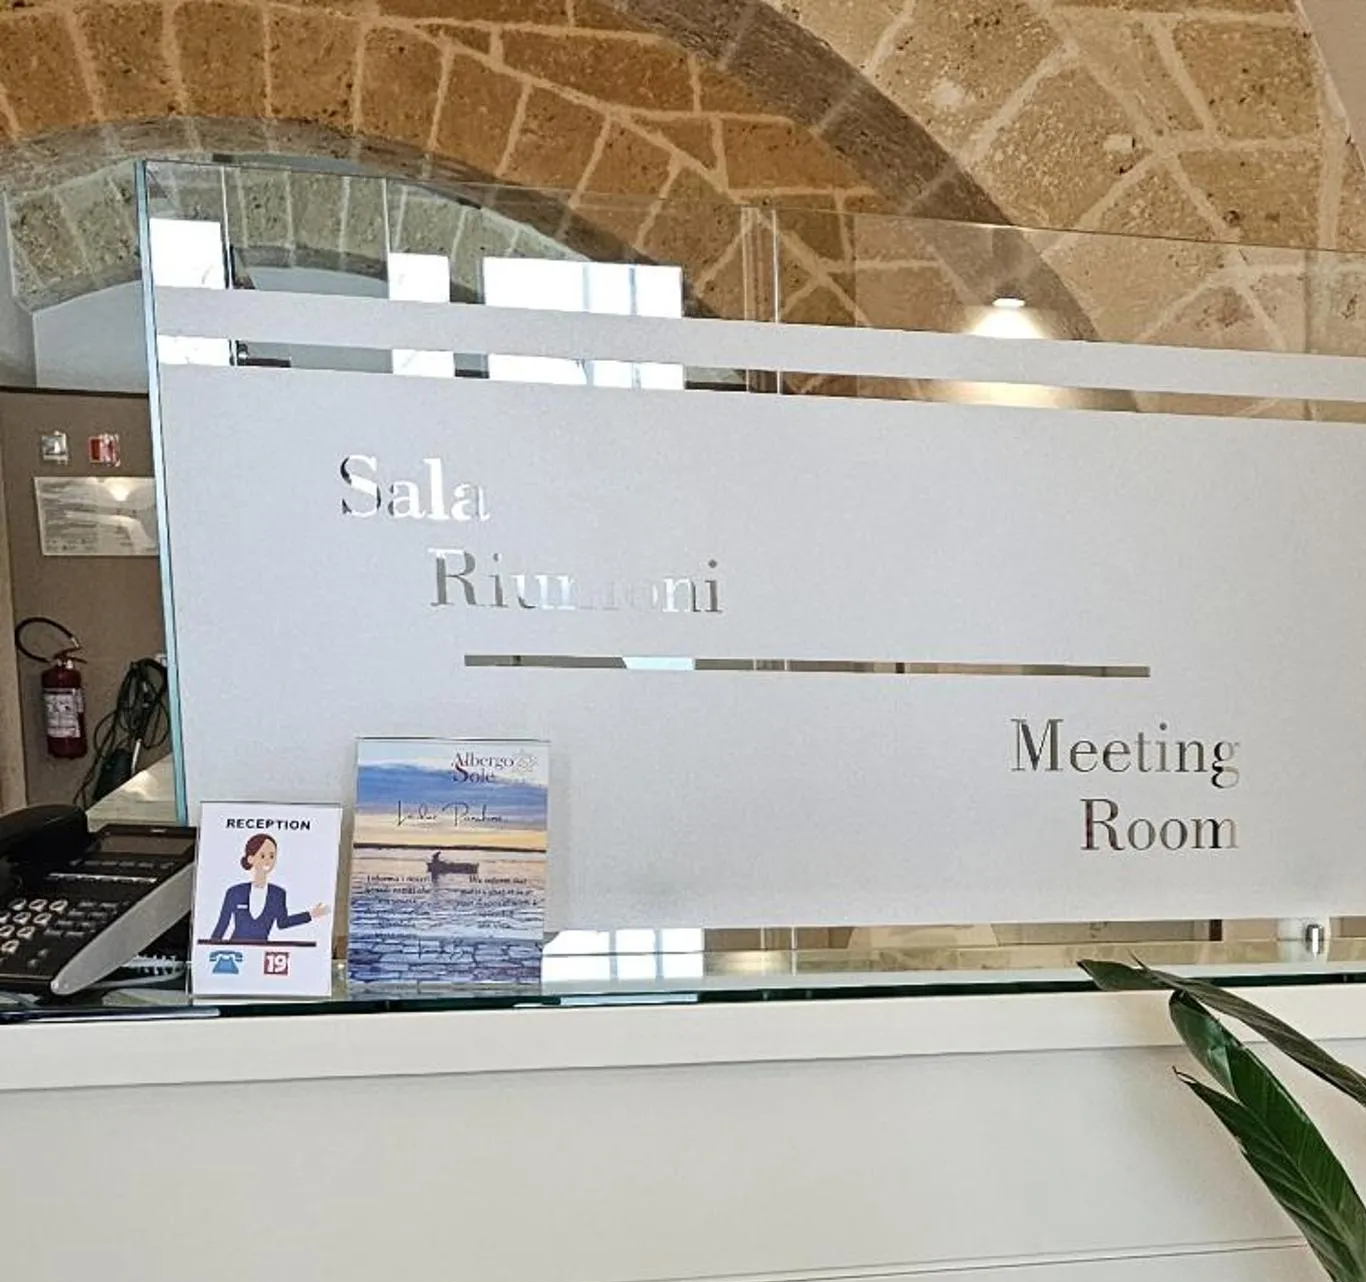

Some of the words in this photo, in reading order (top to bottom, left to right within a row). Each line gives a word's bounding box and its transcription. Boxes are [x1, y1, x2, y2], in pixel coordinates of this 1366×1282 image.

[339, 454, 490, 521] Sala
[428, 547, 722, 613] Riunni
[451, 752, 515, 769] Albergo
[1011, 718, 1240, 789] Meeting
[226, 818, 311, 831] RECEPTION
[1080, 798, 1239, 851] Room
[266, 954, 288, 973] 19
